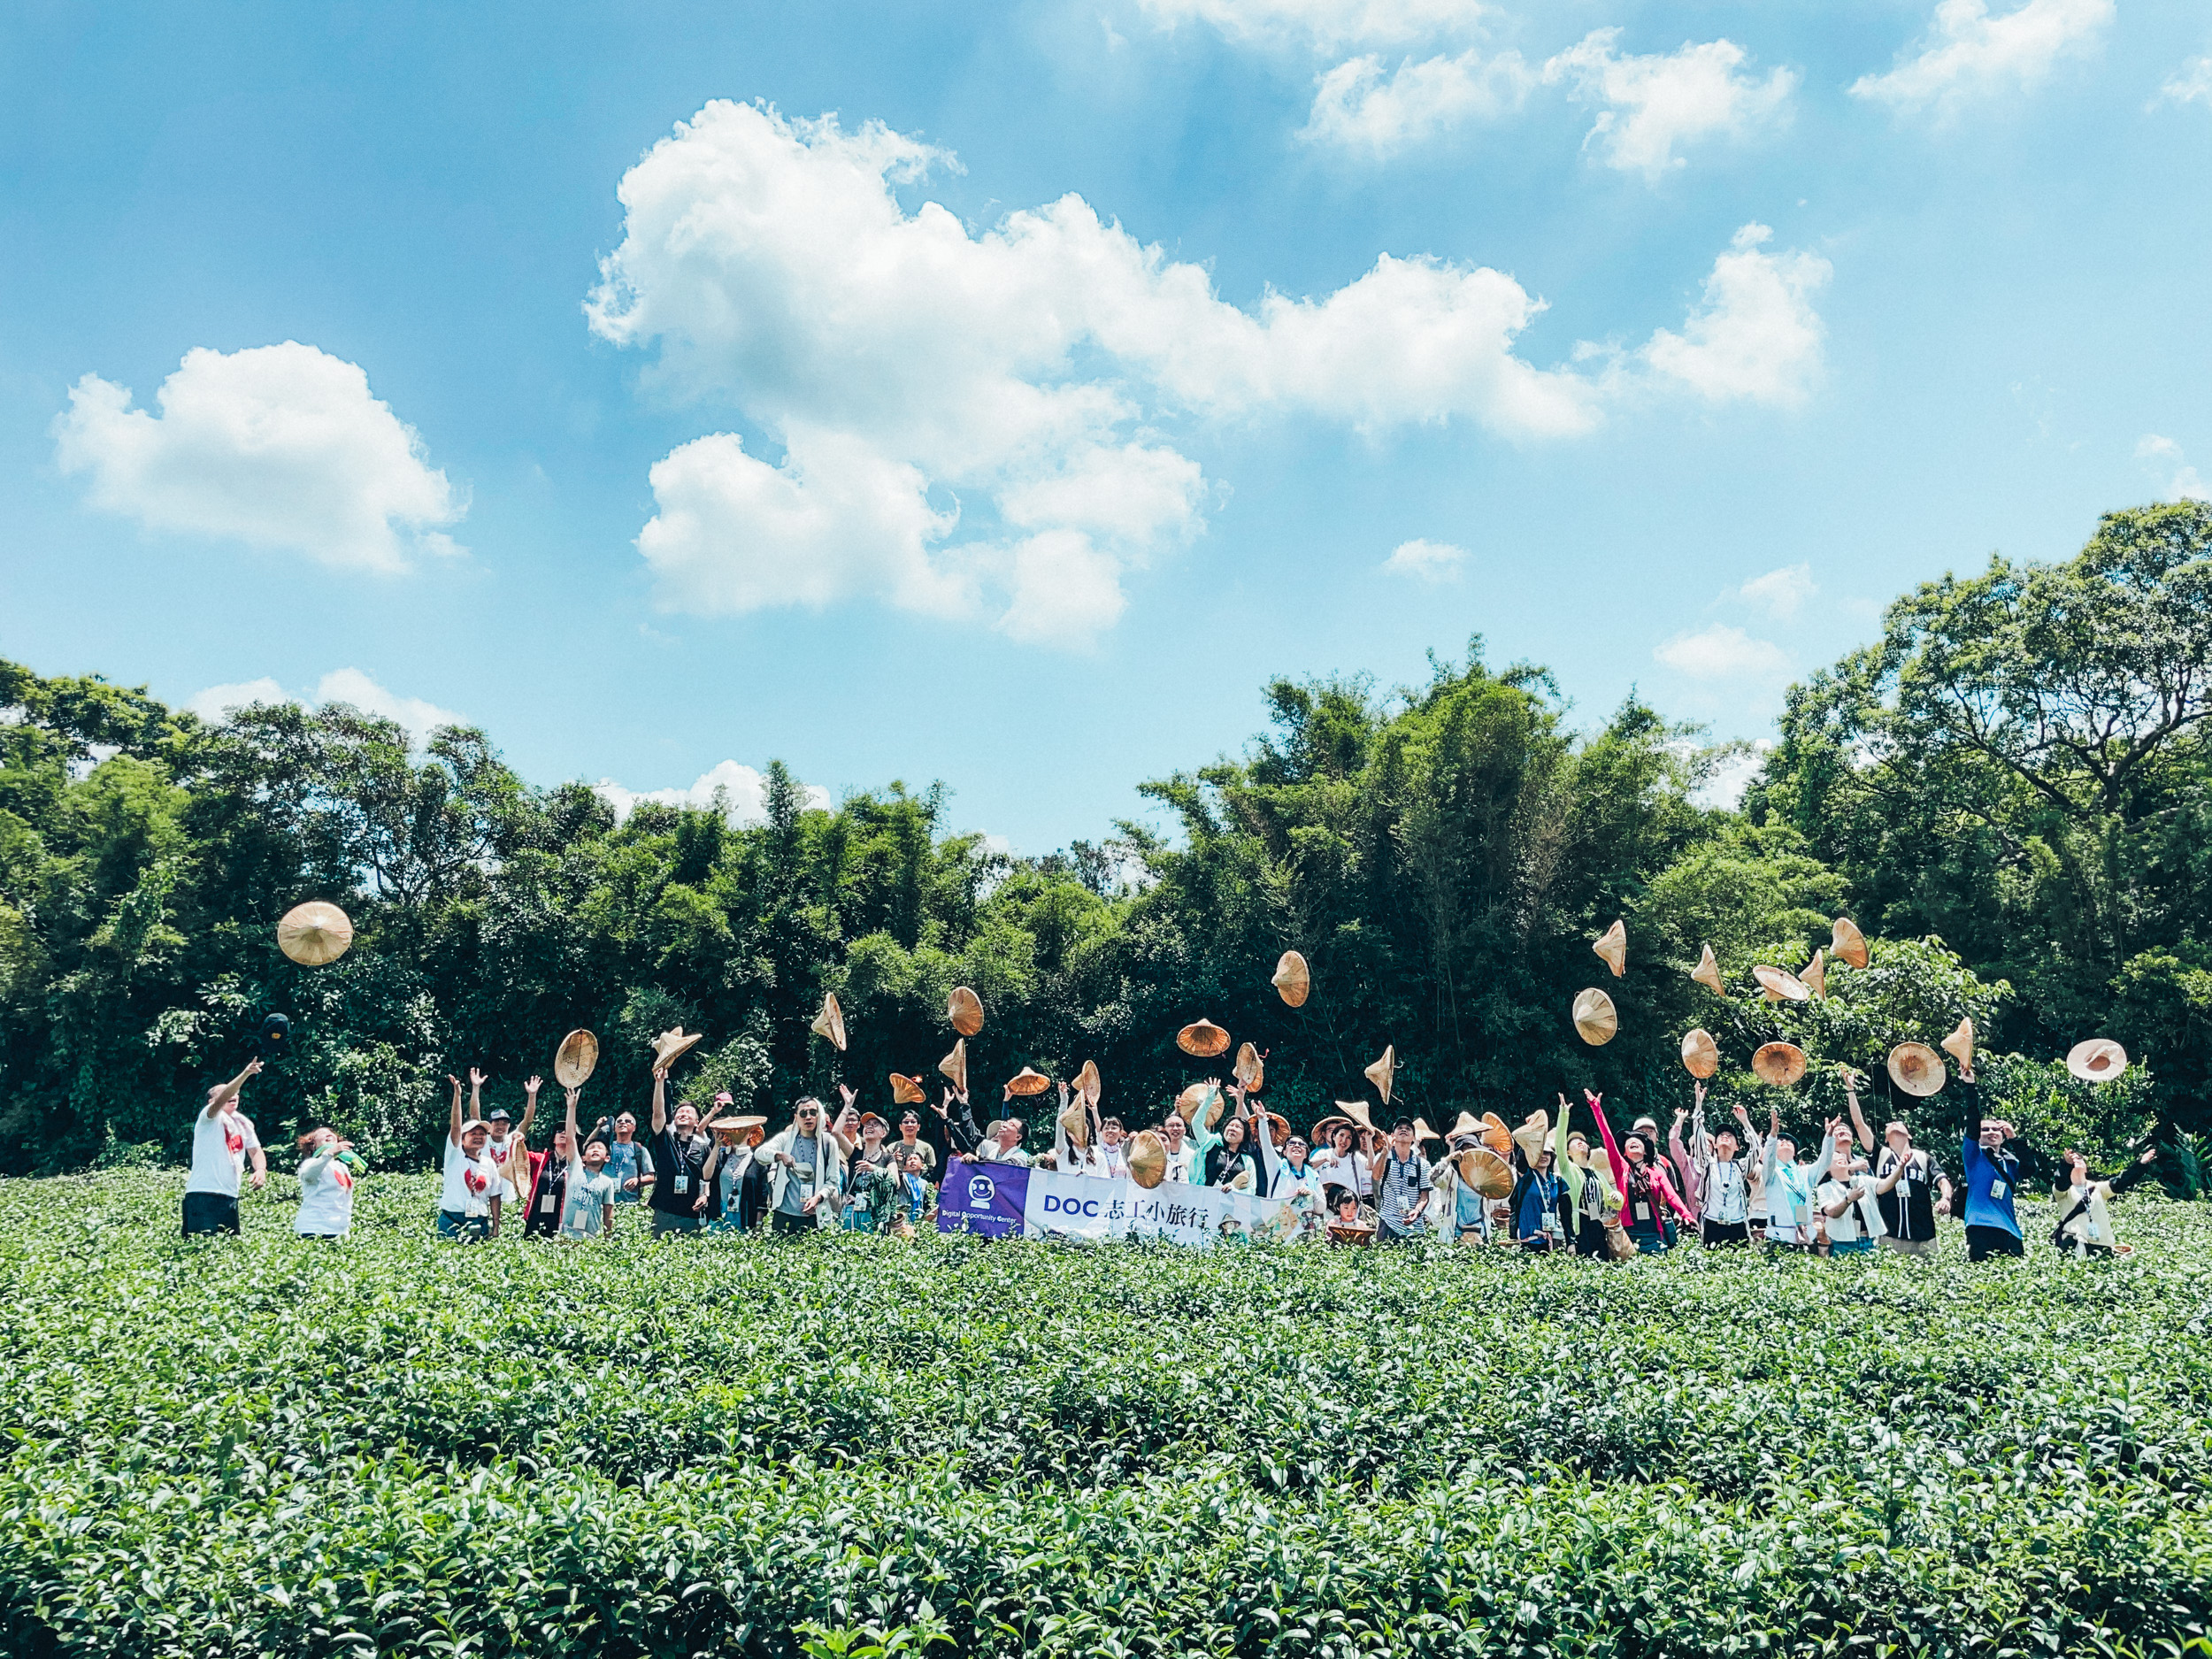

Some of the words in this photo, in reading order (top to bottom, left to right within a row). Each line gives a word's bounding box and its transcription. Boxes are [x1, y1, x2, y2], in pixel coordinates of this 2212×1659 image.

[941, 1210, 961, 1218] Digital
[961, 1211, 996, 1223] Opportunity
[1043, 1194, 1099, 1217] DOC
[1103, 1199, 1210, 1229] 志工小旅行
